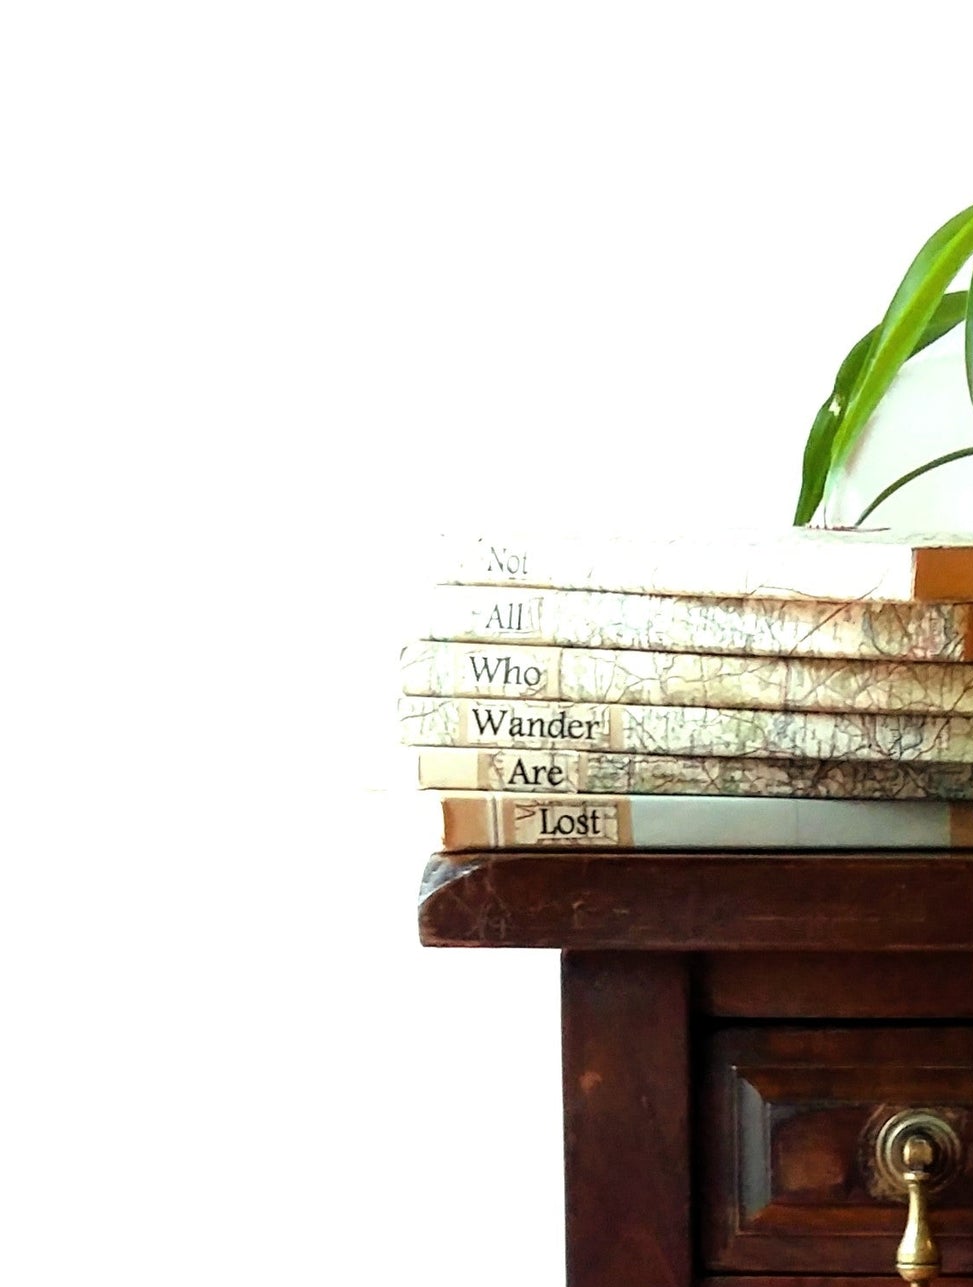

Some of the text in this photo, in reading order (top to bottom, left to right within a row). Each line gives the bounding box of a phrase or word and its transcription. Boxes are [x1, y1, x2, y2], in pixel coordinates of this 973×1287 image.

[487, 546, 528, 575] Not
[485, 603, 523, 631] All
[469, 656, 542, 686] Who
[472, 708, 600, 740] Wander
[507, 758, 564, 786] Are
[539, 807, 601, 836] Lost
